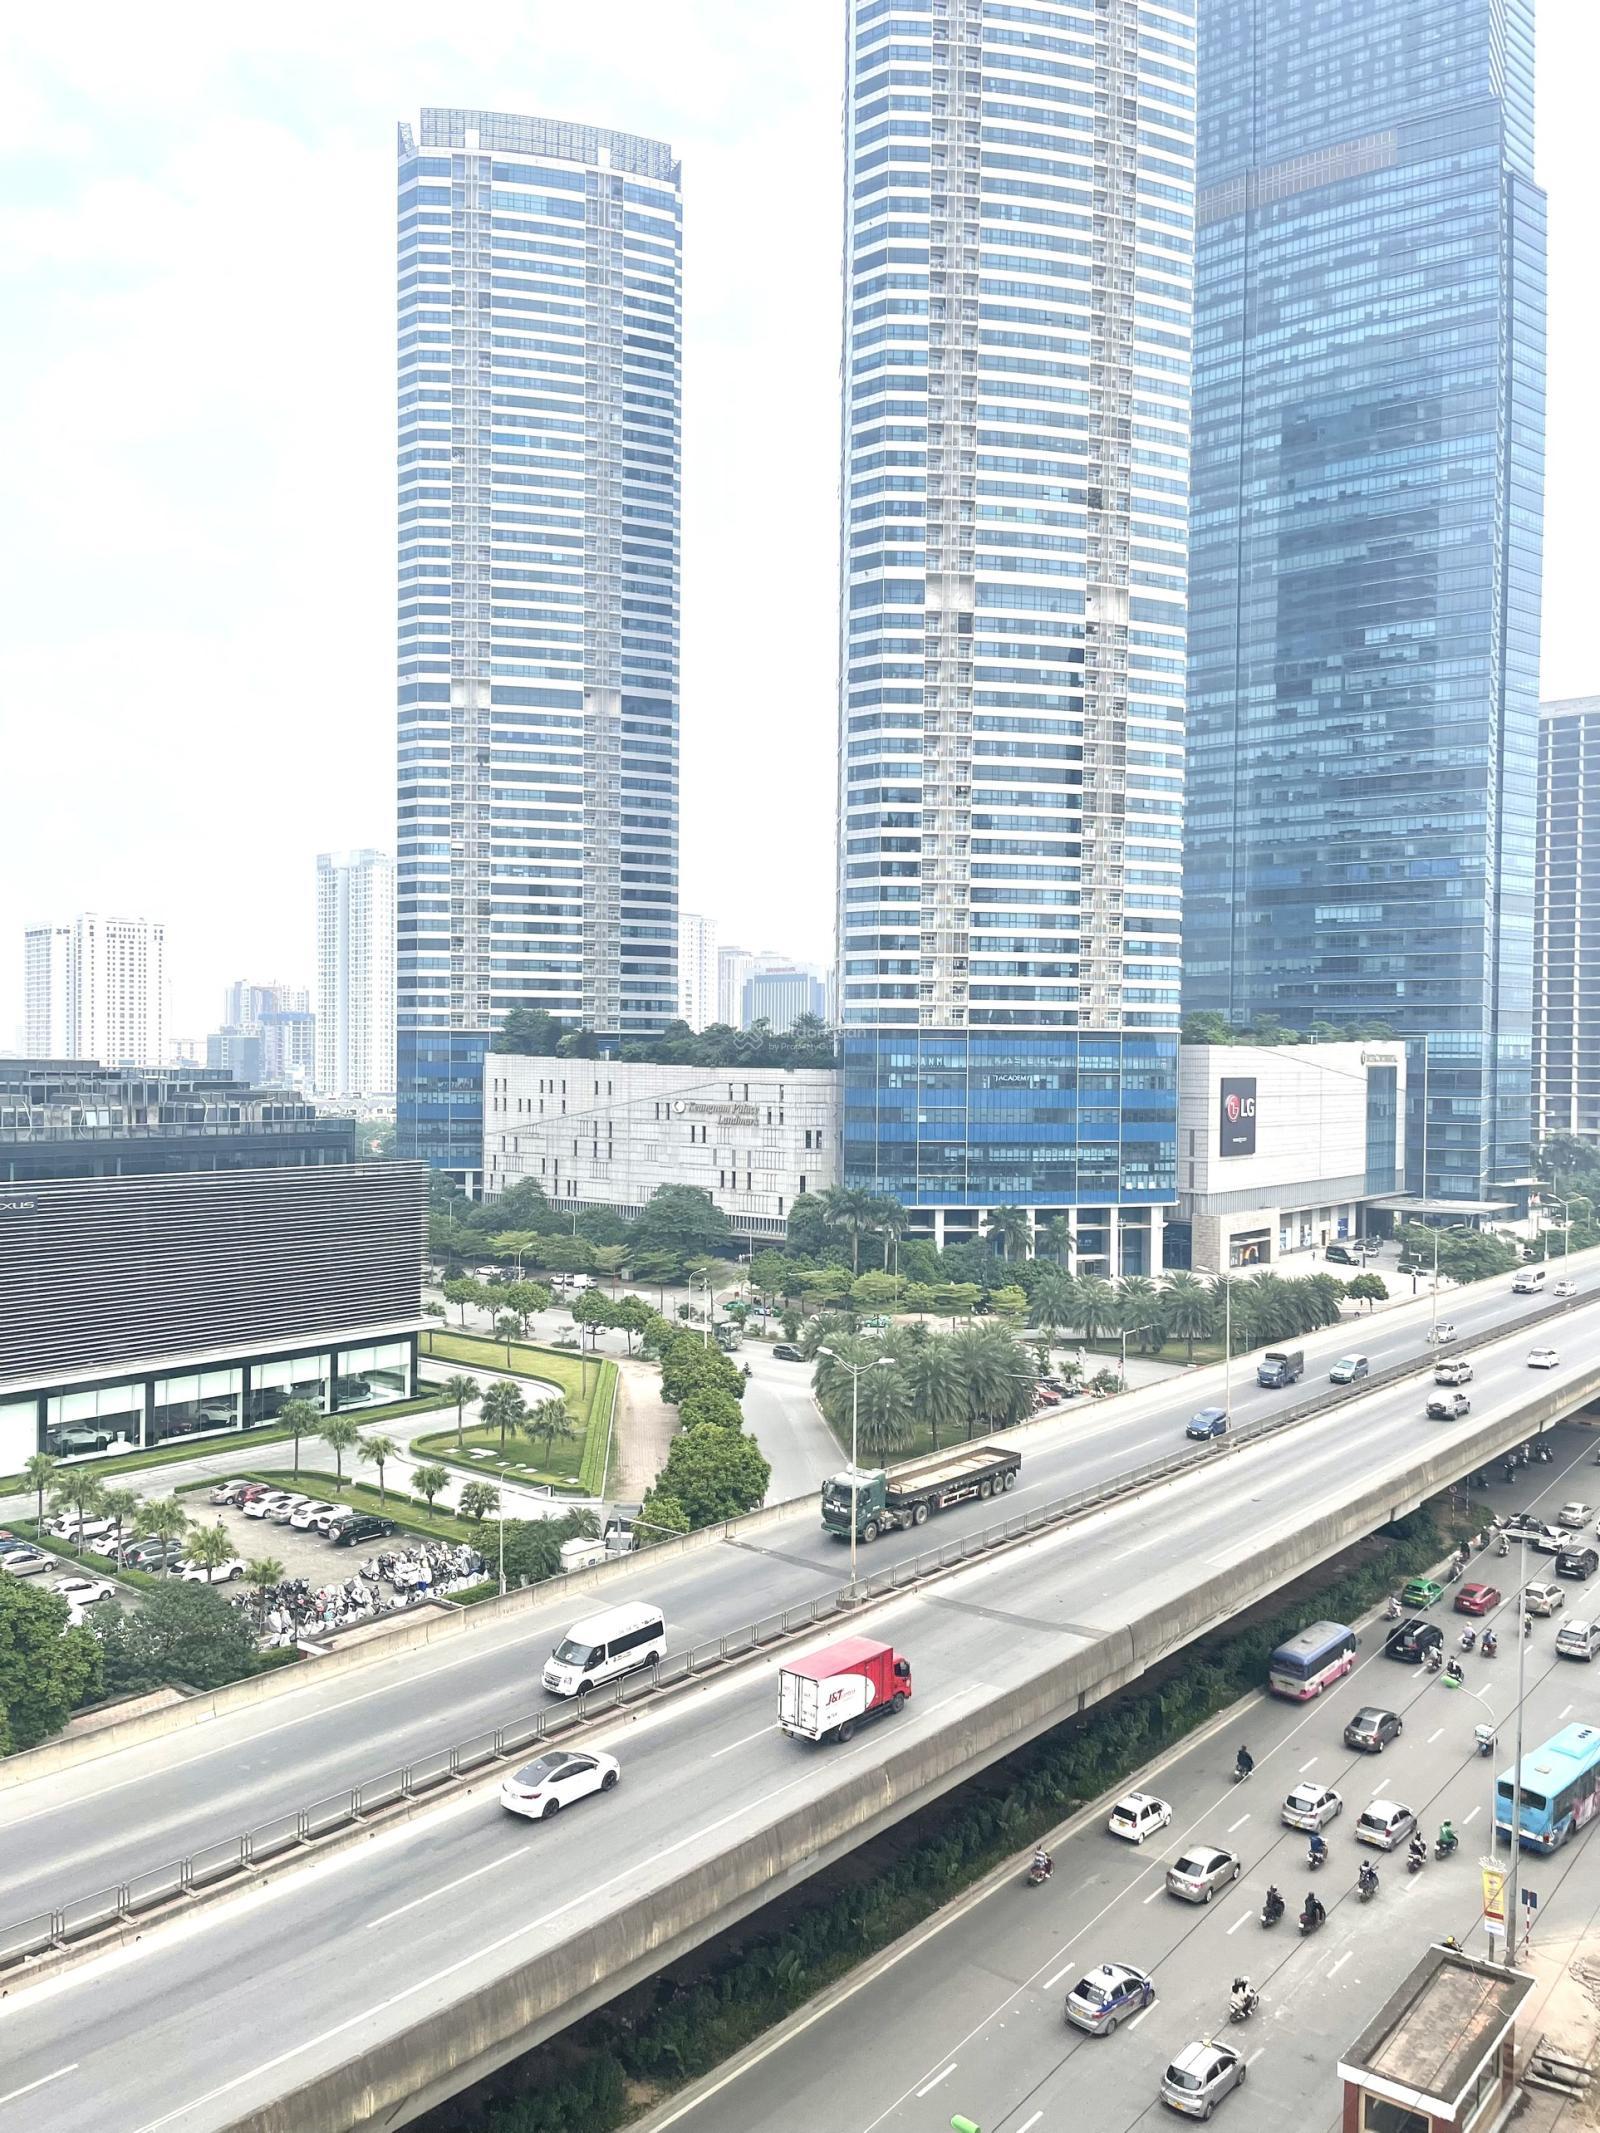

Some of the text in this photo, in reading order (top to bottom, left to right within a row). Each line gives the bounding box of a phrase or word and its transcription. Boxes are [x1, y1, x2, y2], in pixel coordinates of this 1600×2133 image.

[1240, 1098, 1255, 1117] LG
[0, 1201, 35, 1210] XUS
[825, 1689, 845, 1707] J&T
